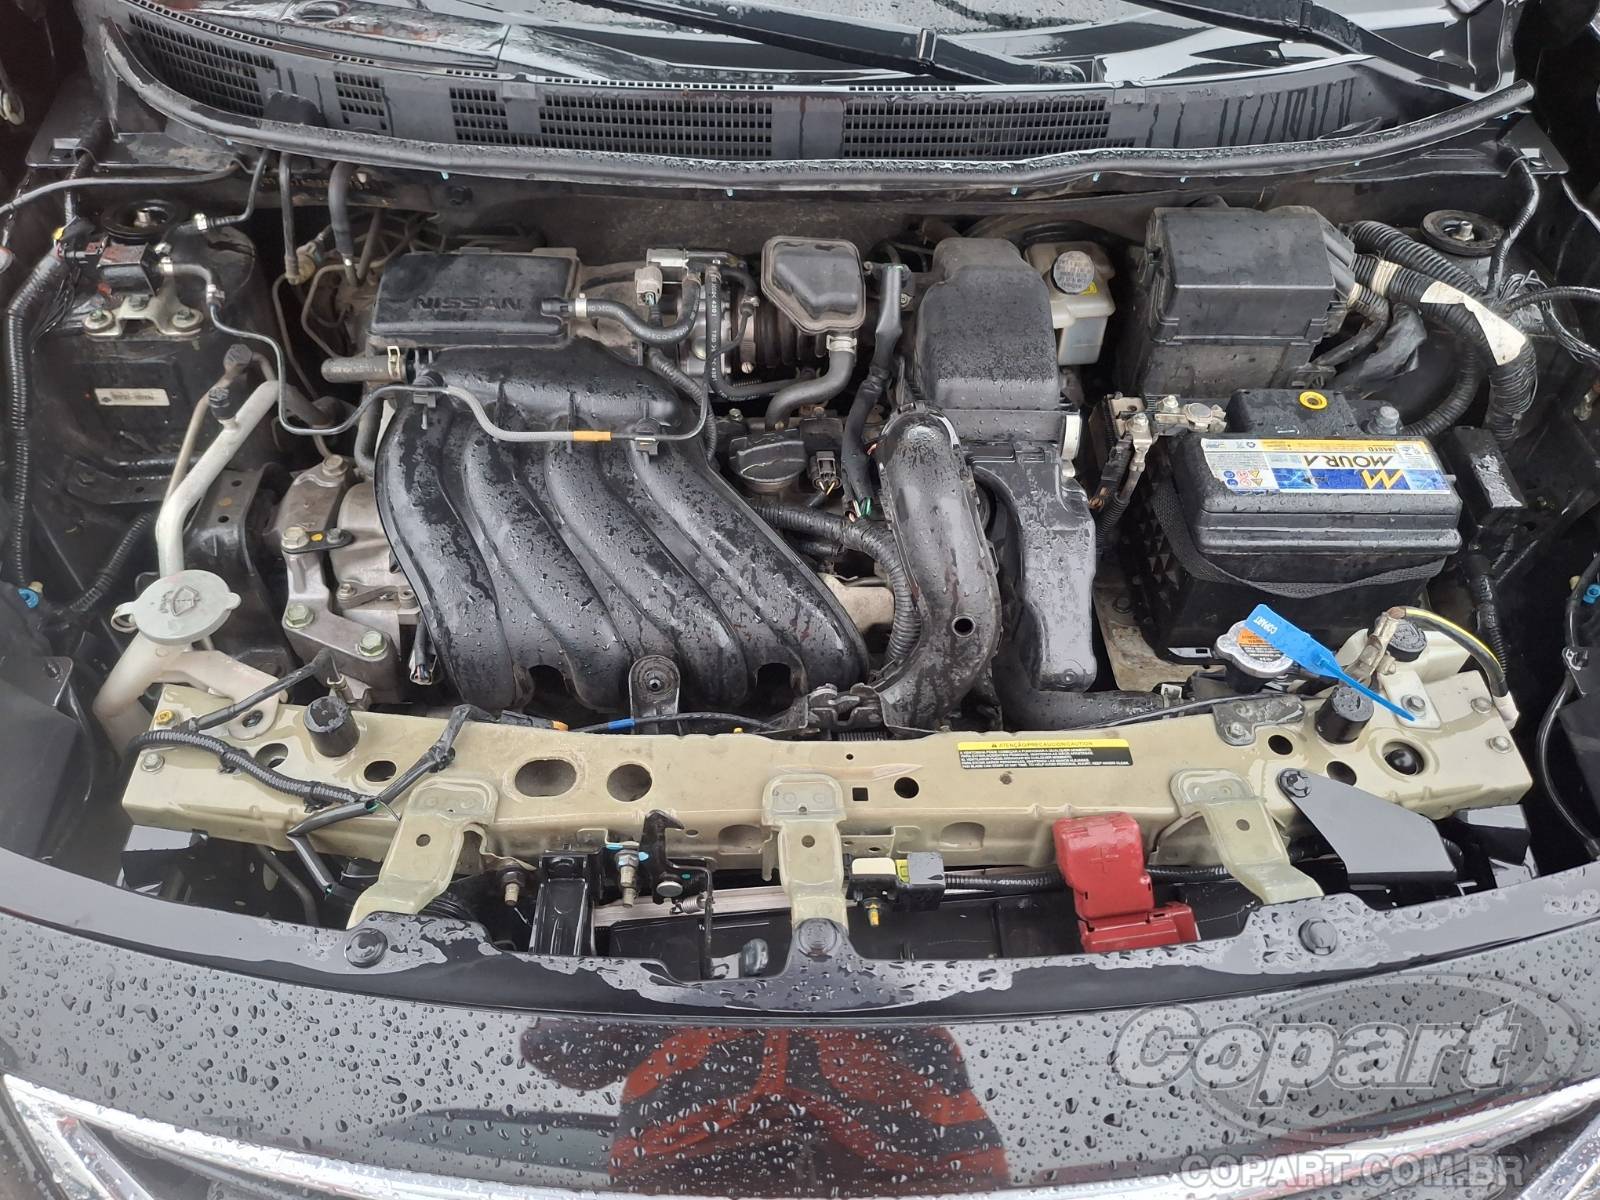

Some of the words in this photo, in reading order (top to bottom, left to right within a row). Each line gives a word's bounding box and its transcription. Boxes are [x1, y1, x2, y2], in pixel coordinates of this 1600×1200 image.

[414, 296, 521, 310] NISSAN
[1303, 455, 1393, 468] MOURA
[1253, 616, 1278, 634] COPART
